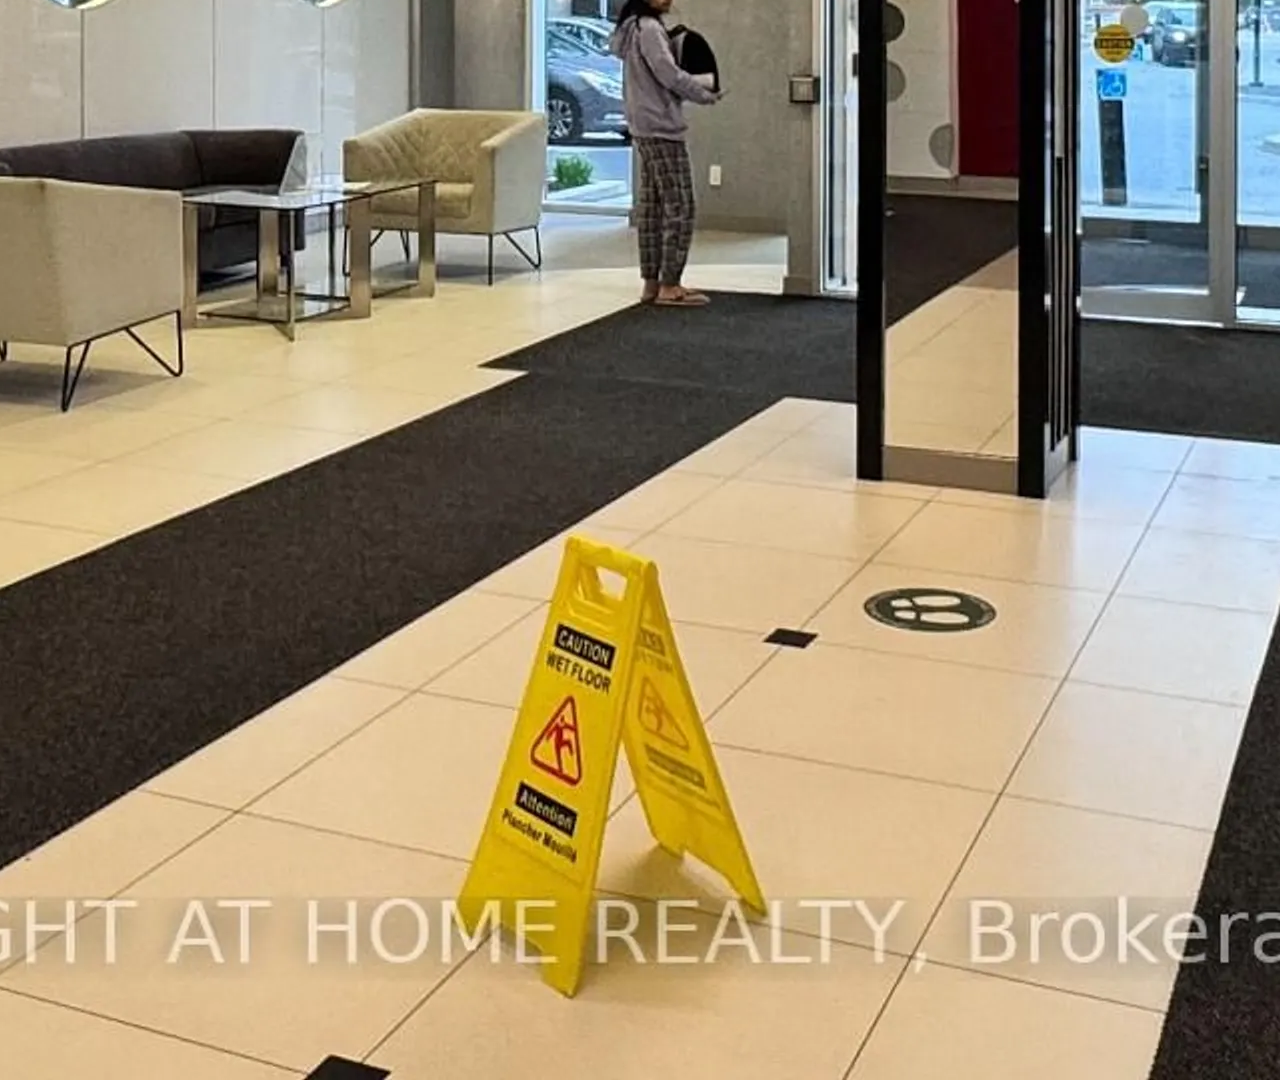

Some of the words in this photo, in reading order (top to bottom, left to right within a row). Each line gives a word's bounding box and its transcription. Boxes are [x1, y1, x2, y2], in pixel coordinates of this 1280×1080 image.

[558, 629, 610, 665] CAUTION
[546, 651, 572, 676] WET
[570, 662, 612, 696] FLOOR
[520, 788, 573, 831] Attention
